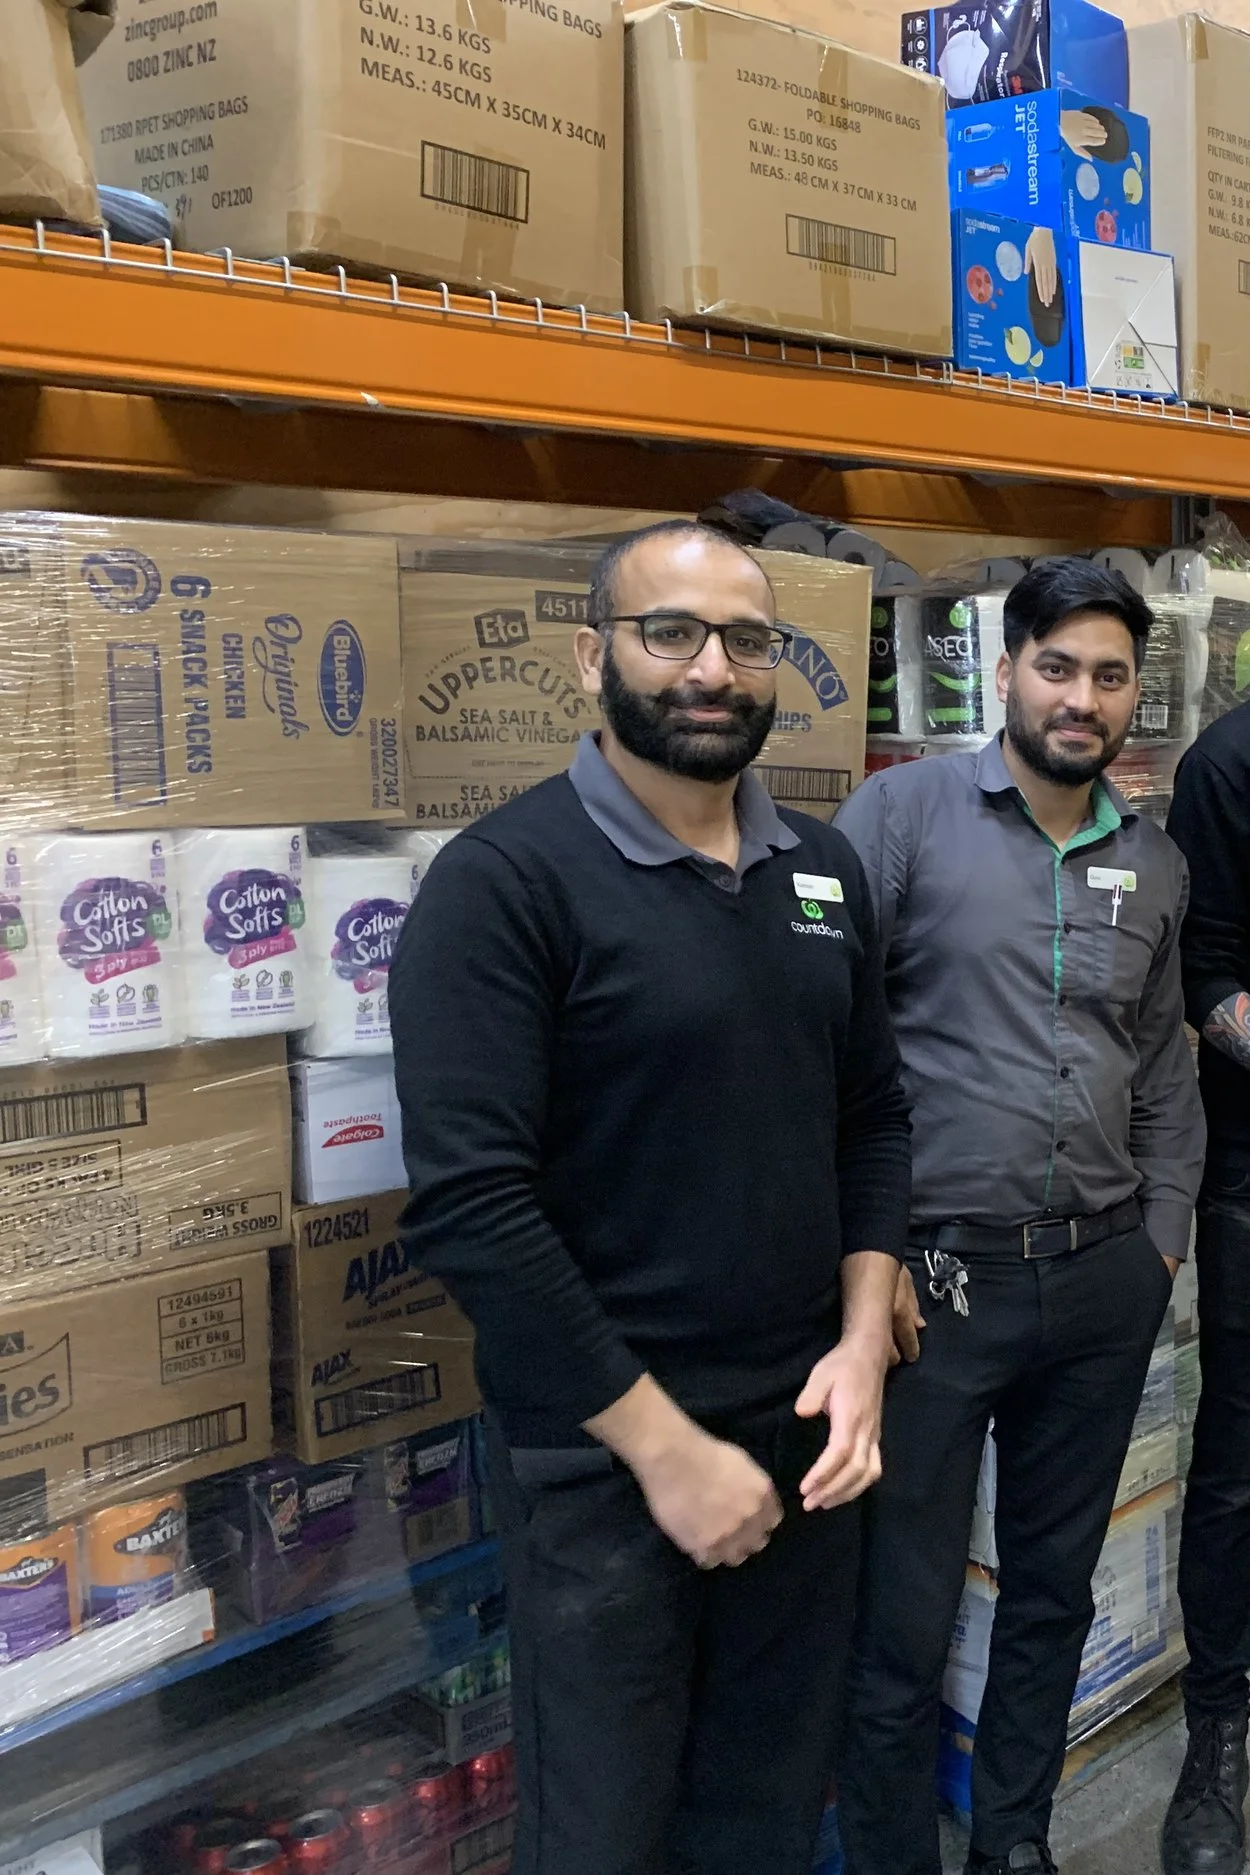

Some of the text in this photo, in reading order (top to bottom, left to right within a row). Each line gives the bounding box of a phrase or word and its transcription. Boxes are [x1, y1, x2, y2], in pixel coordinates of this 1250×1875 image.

[125, 1, 217, 41] zincgroup.com
[359, 0, 491, 54] G.W.: 13.6 KGS
[563, 10, 602, 39] BAGS
[127, 39, 217, 82] 0800 ZINC NZ
[360, 26, 492, 83] N.W.: 12.6 KGS
[135, 115, 159, 136] RPET
[162, 102, 215, 130] SHOPPING
[218, 96, 248, 118] BAGS
[361, 57, 606, 150] MEAS.: 45CM X 35CM X 34CM
[784, 81, 837, 106] FOLDABLE
[840, 97, 892, 123] SHOPPING
[895, 113, 921, 131] BAGS
[1014, 104, 1026, 133] JET
[748, 118, 837, 151] G.W.: 15.00 KGS
[829, 113, 861, 134] 16848
[134, 134, 213, 164] MADE IN CHINA
[749, 140, 838, 172] N.W.: 13.50 KGS
[1027, 101, 1038, 206] sodastream
[1207, 144, 1244, 166] FILTERING
[191, 165, 209, 184] 140
[750, 162, 917, 212] MEAS.: 48 CM X 37 CM X 33 CM
[1208, 170, 1223, 184] QTY
[1224, 176, 1232, 187] IN
[966, 226, 976, 235] JET
[481, 614, 524, 644] Eta
[170, 575, 213, 774] 6 SNACK PACKS
[222, 632, 246, 719] CHICKEN
[253, 613, 310, 740] Originals
[331, 634, 356, 726] Bluebird
[418, 656, 587, 719] UPPERCUTS
[460, 708, 552, 726] SEA SALT &
[773, 709, 812, 733] HIPS
[416, 725, 583, 744] BALSAMIC VINEGA
[378, 717, 400, 808] 320027347
[460, 785, 492, 801] SEA
[6, 847, 17, 865] 6
[151, 839, 163, 856] 6
[290, 835, 300, 851] 6
[411, 864, 419, 881] 6
[73, 888, 148, 926] Cotton
[219, 883, 286, 914] Cotton
[80, 918, 145, 952] Softs
[225, 907, 283, 939] Softs
[790, 920, 844, 940] countdown
[249, 944, 267, 959] ply
[352, 934, 400, 965] Soft
[94, 956, 127, 980] 3 ply
[323, 1113, 382, 1129] Toothpaste
[332, 1128, 380, 1143] Colgate
[202, 1200, 249, 1220] 3.5KG
[233, 1215, 278, 1236] GROSS
[303, 1208, 370, 1248] 1224521
[203, 1310, 224, 1322] 1kg
[175, 1335, 201, 1352] NET
[165, 1355, 206, 1374] GROSS
[311, 1350, 351, 1388] AJAX
